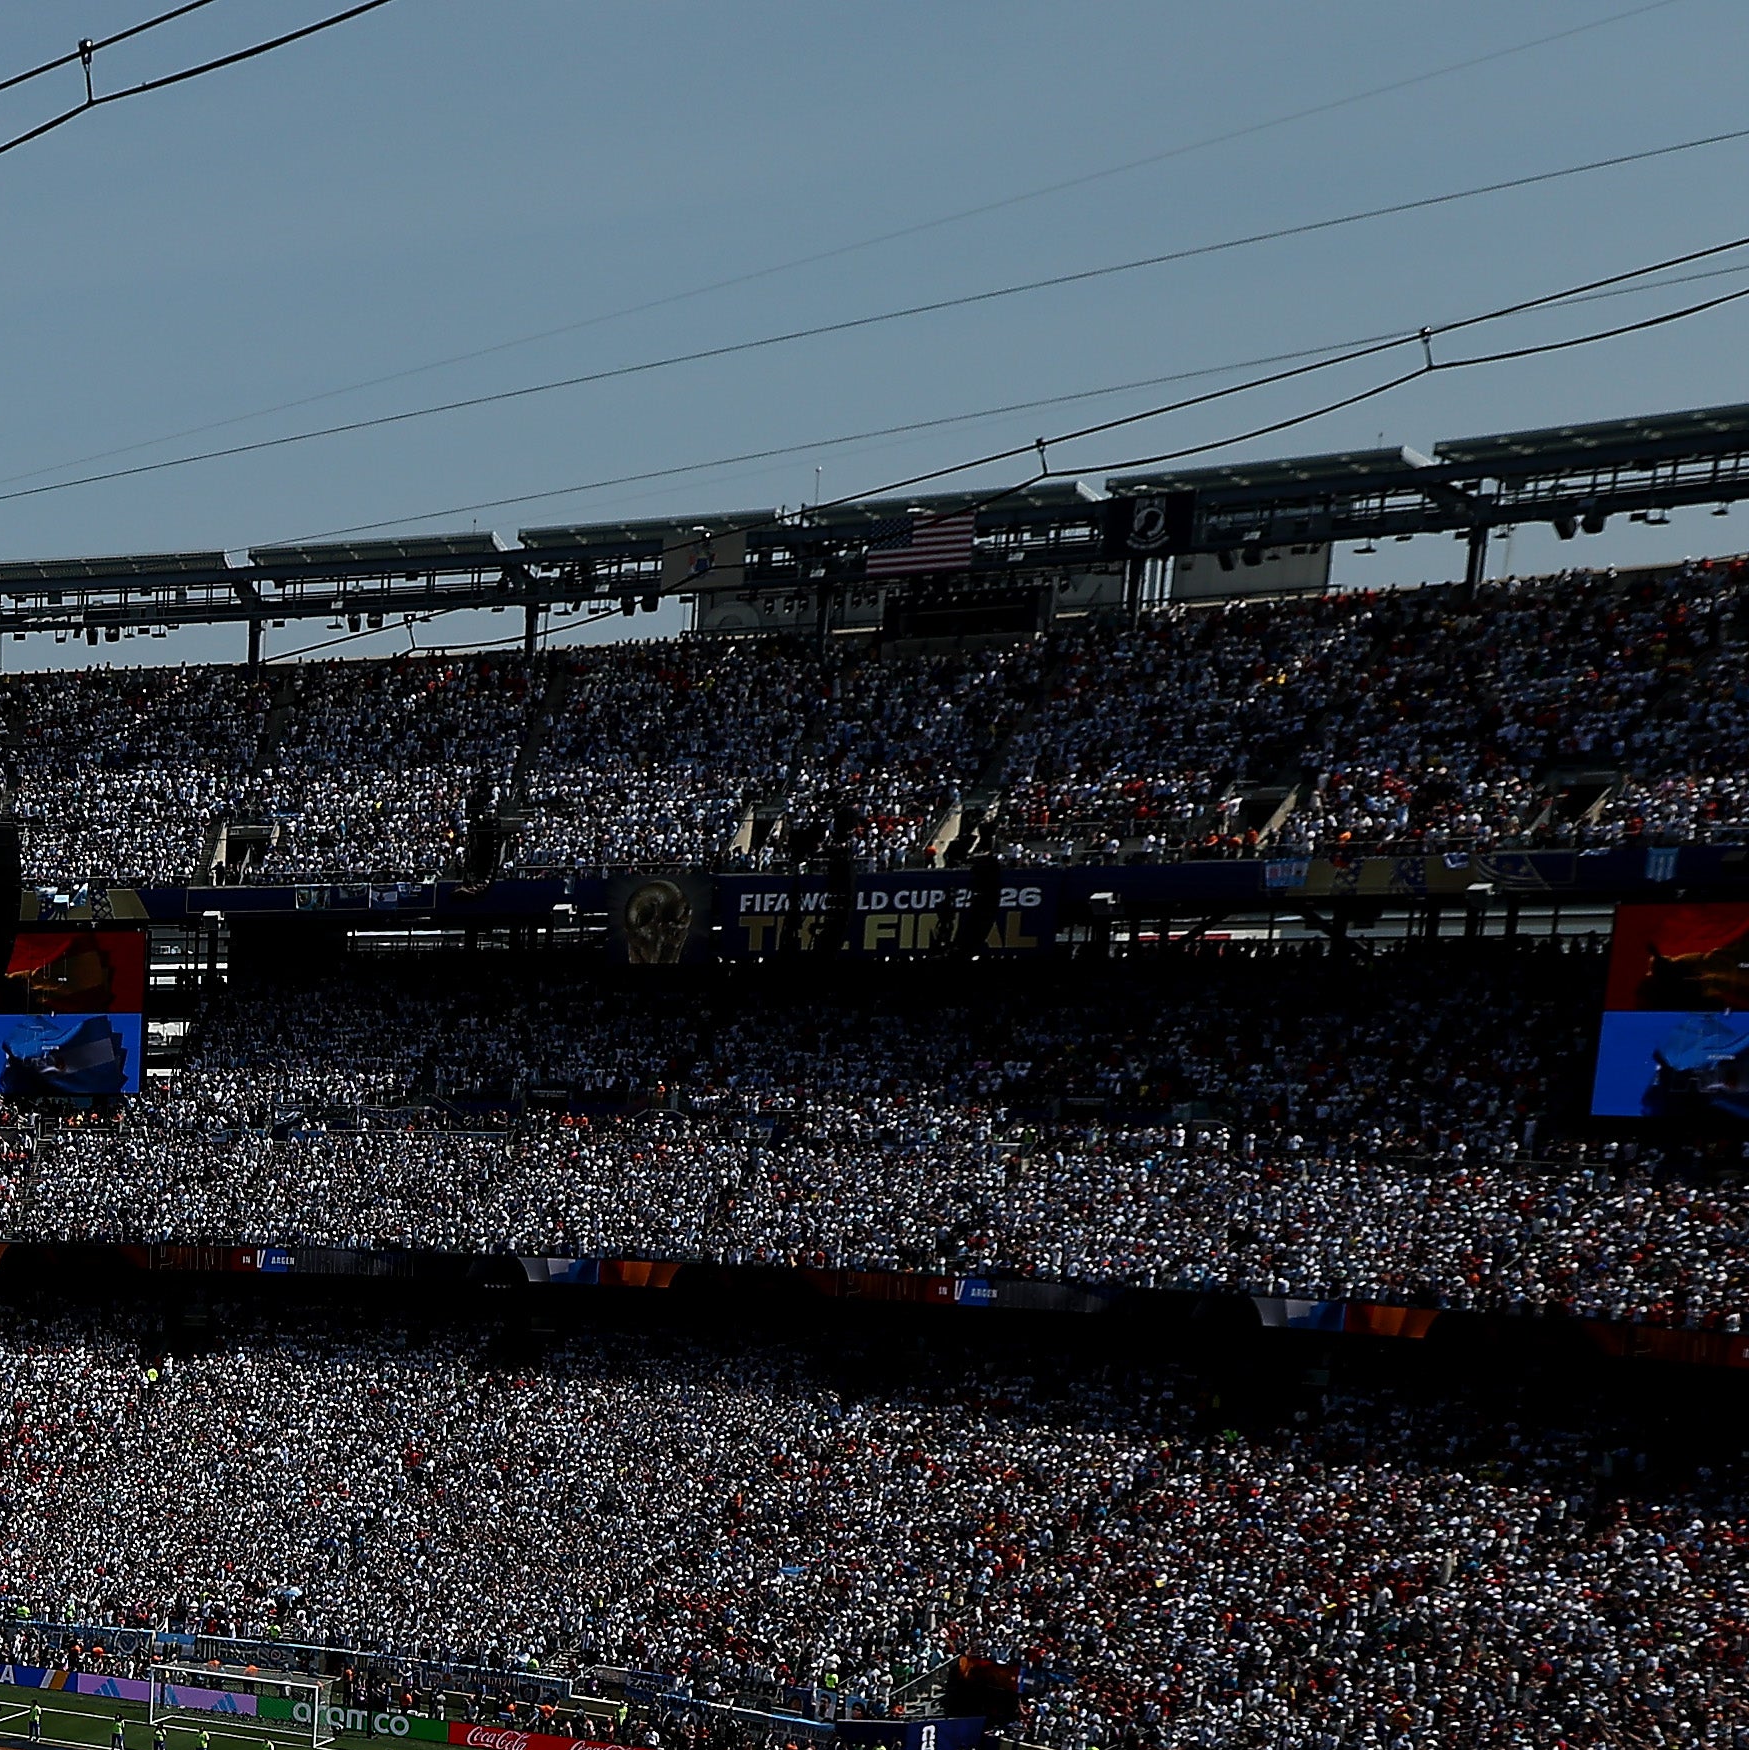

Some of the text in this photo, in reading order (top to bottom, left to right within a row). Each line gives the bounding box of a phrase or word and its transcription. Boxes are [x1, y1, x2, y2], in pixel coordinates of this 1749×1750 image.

[739, 887, 1042, 912] FIFA WLD CUP 226
[292, 1701, 410, 1737] aramco
